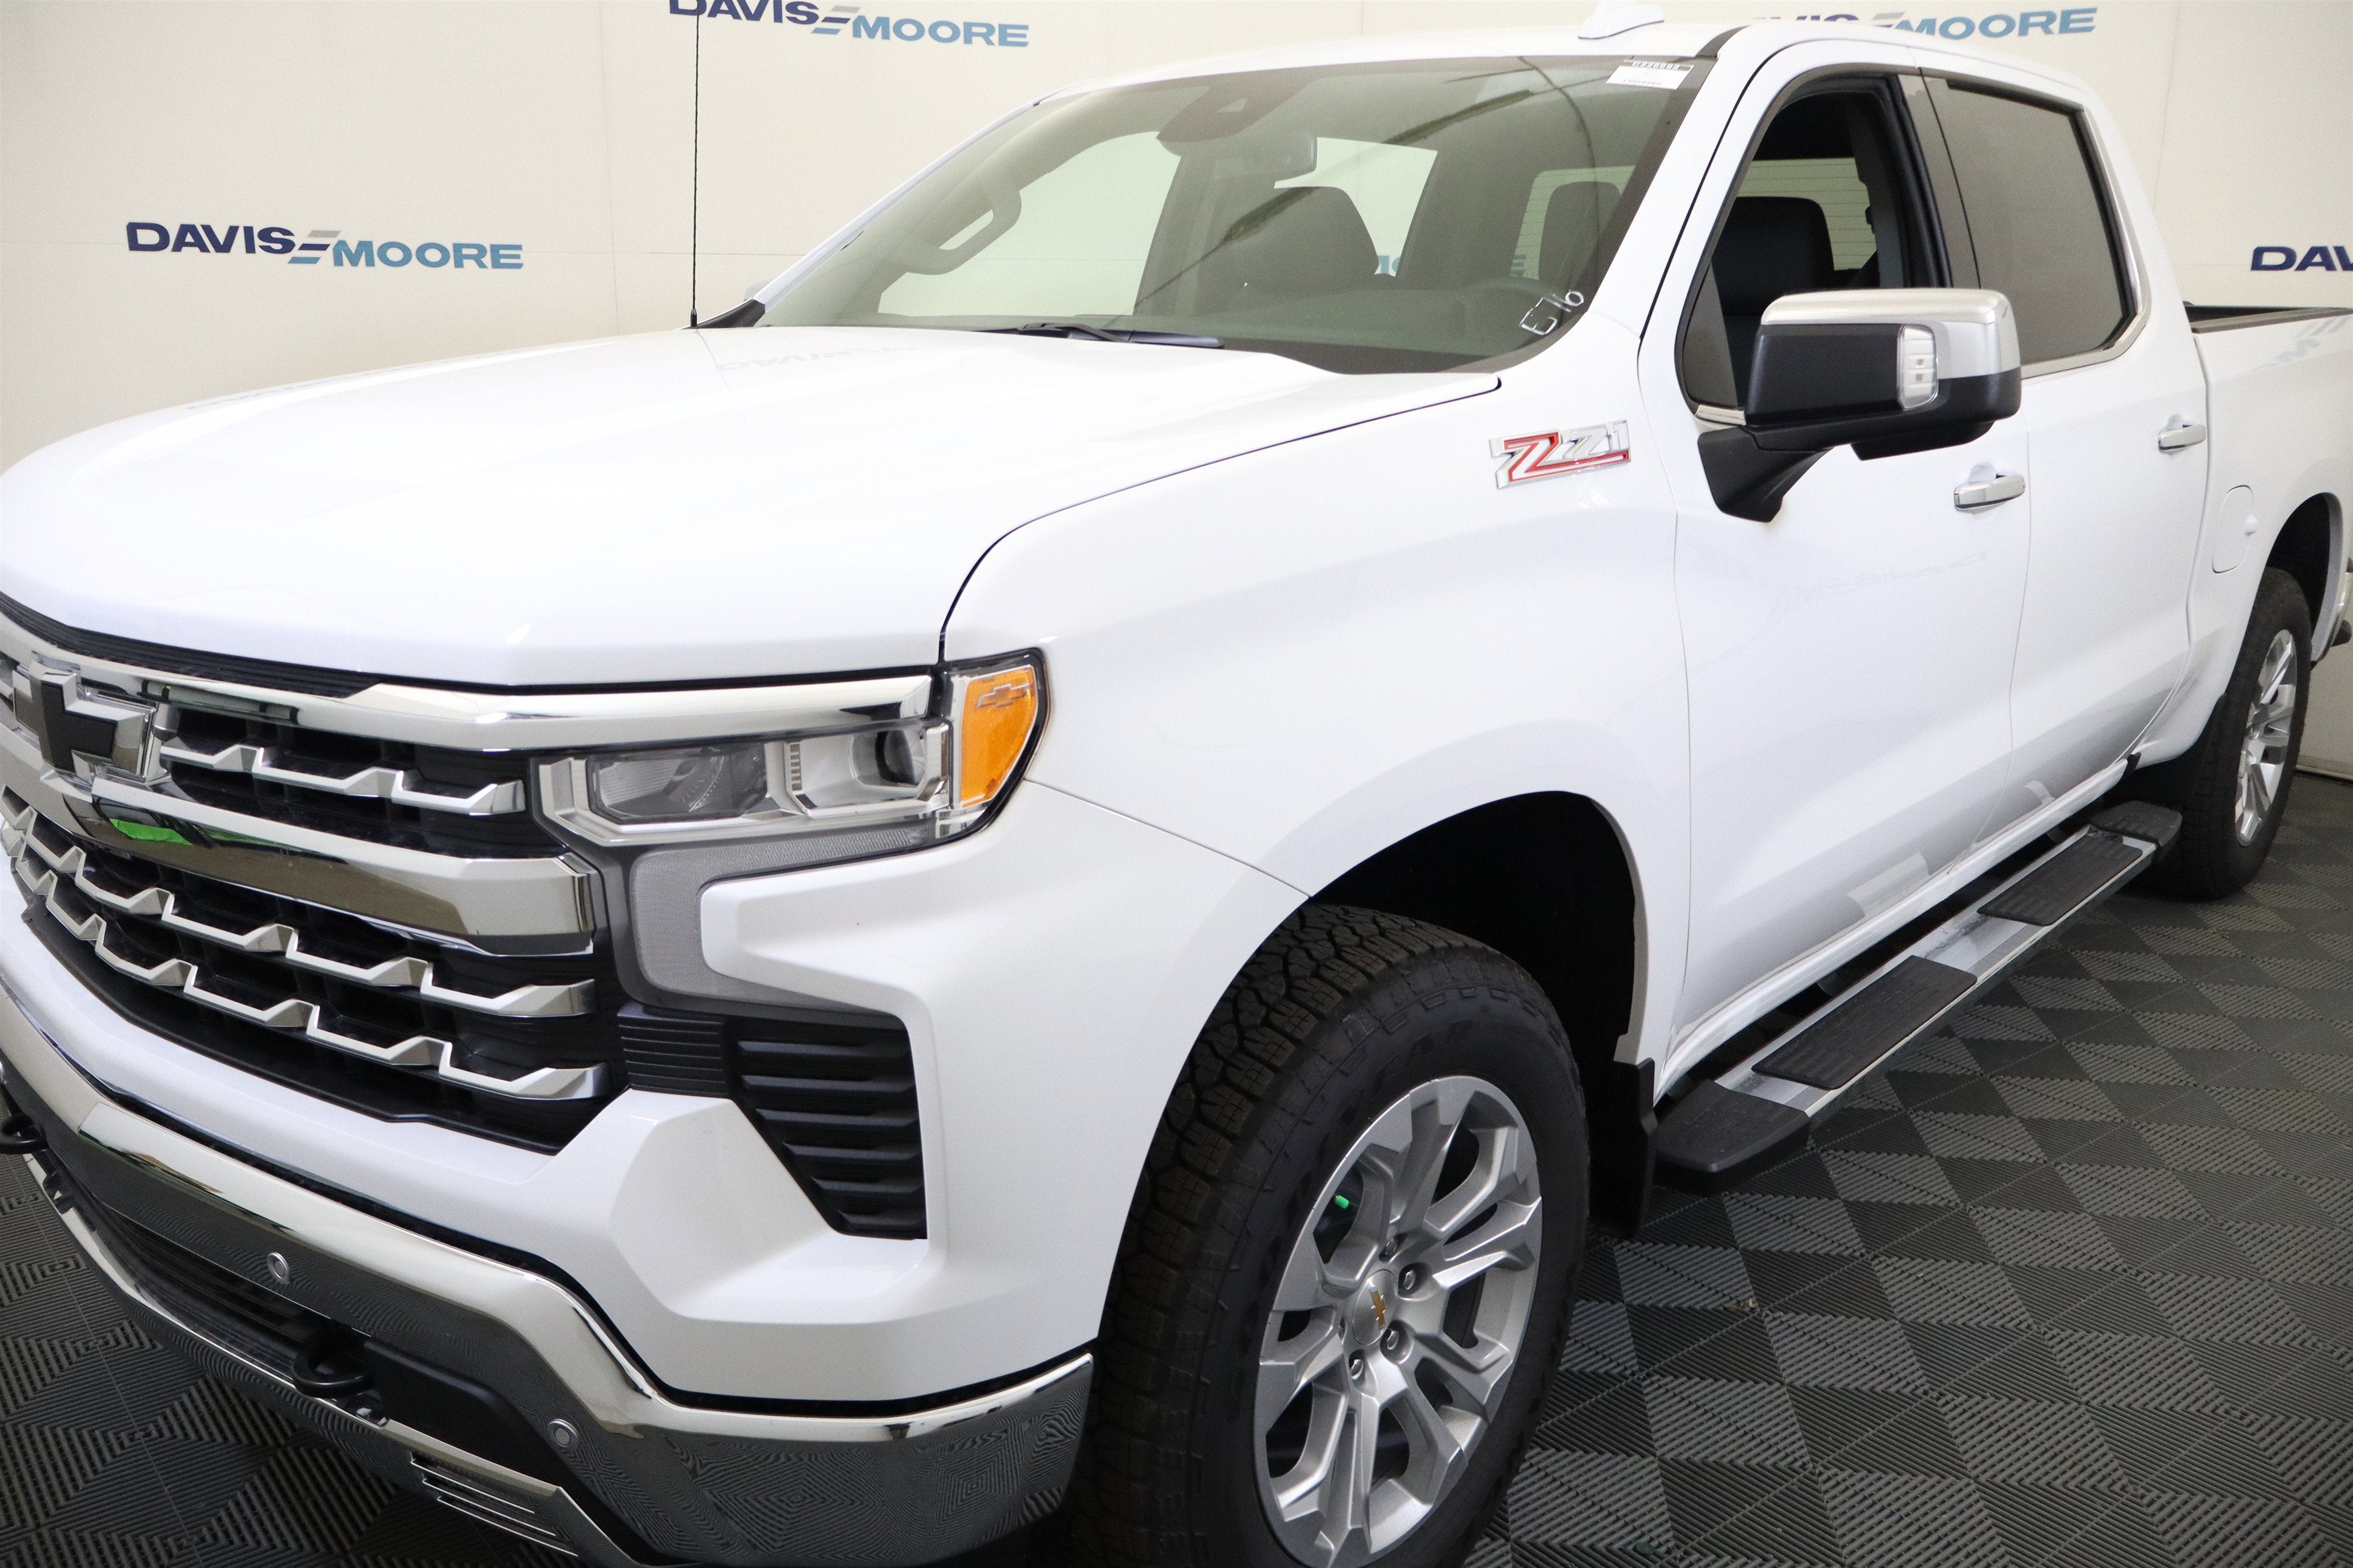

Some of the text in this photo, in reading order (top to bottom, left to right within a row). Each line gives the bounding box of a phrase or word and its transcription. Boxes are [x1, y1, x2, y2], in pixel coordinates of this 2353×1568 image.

[852, 15, 1029, 47] MOORE
[126, 222, 523, 269] DAVIS MOORE
[1489, 419, 1631, 489] Z71
